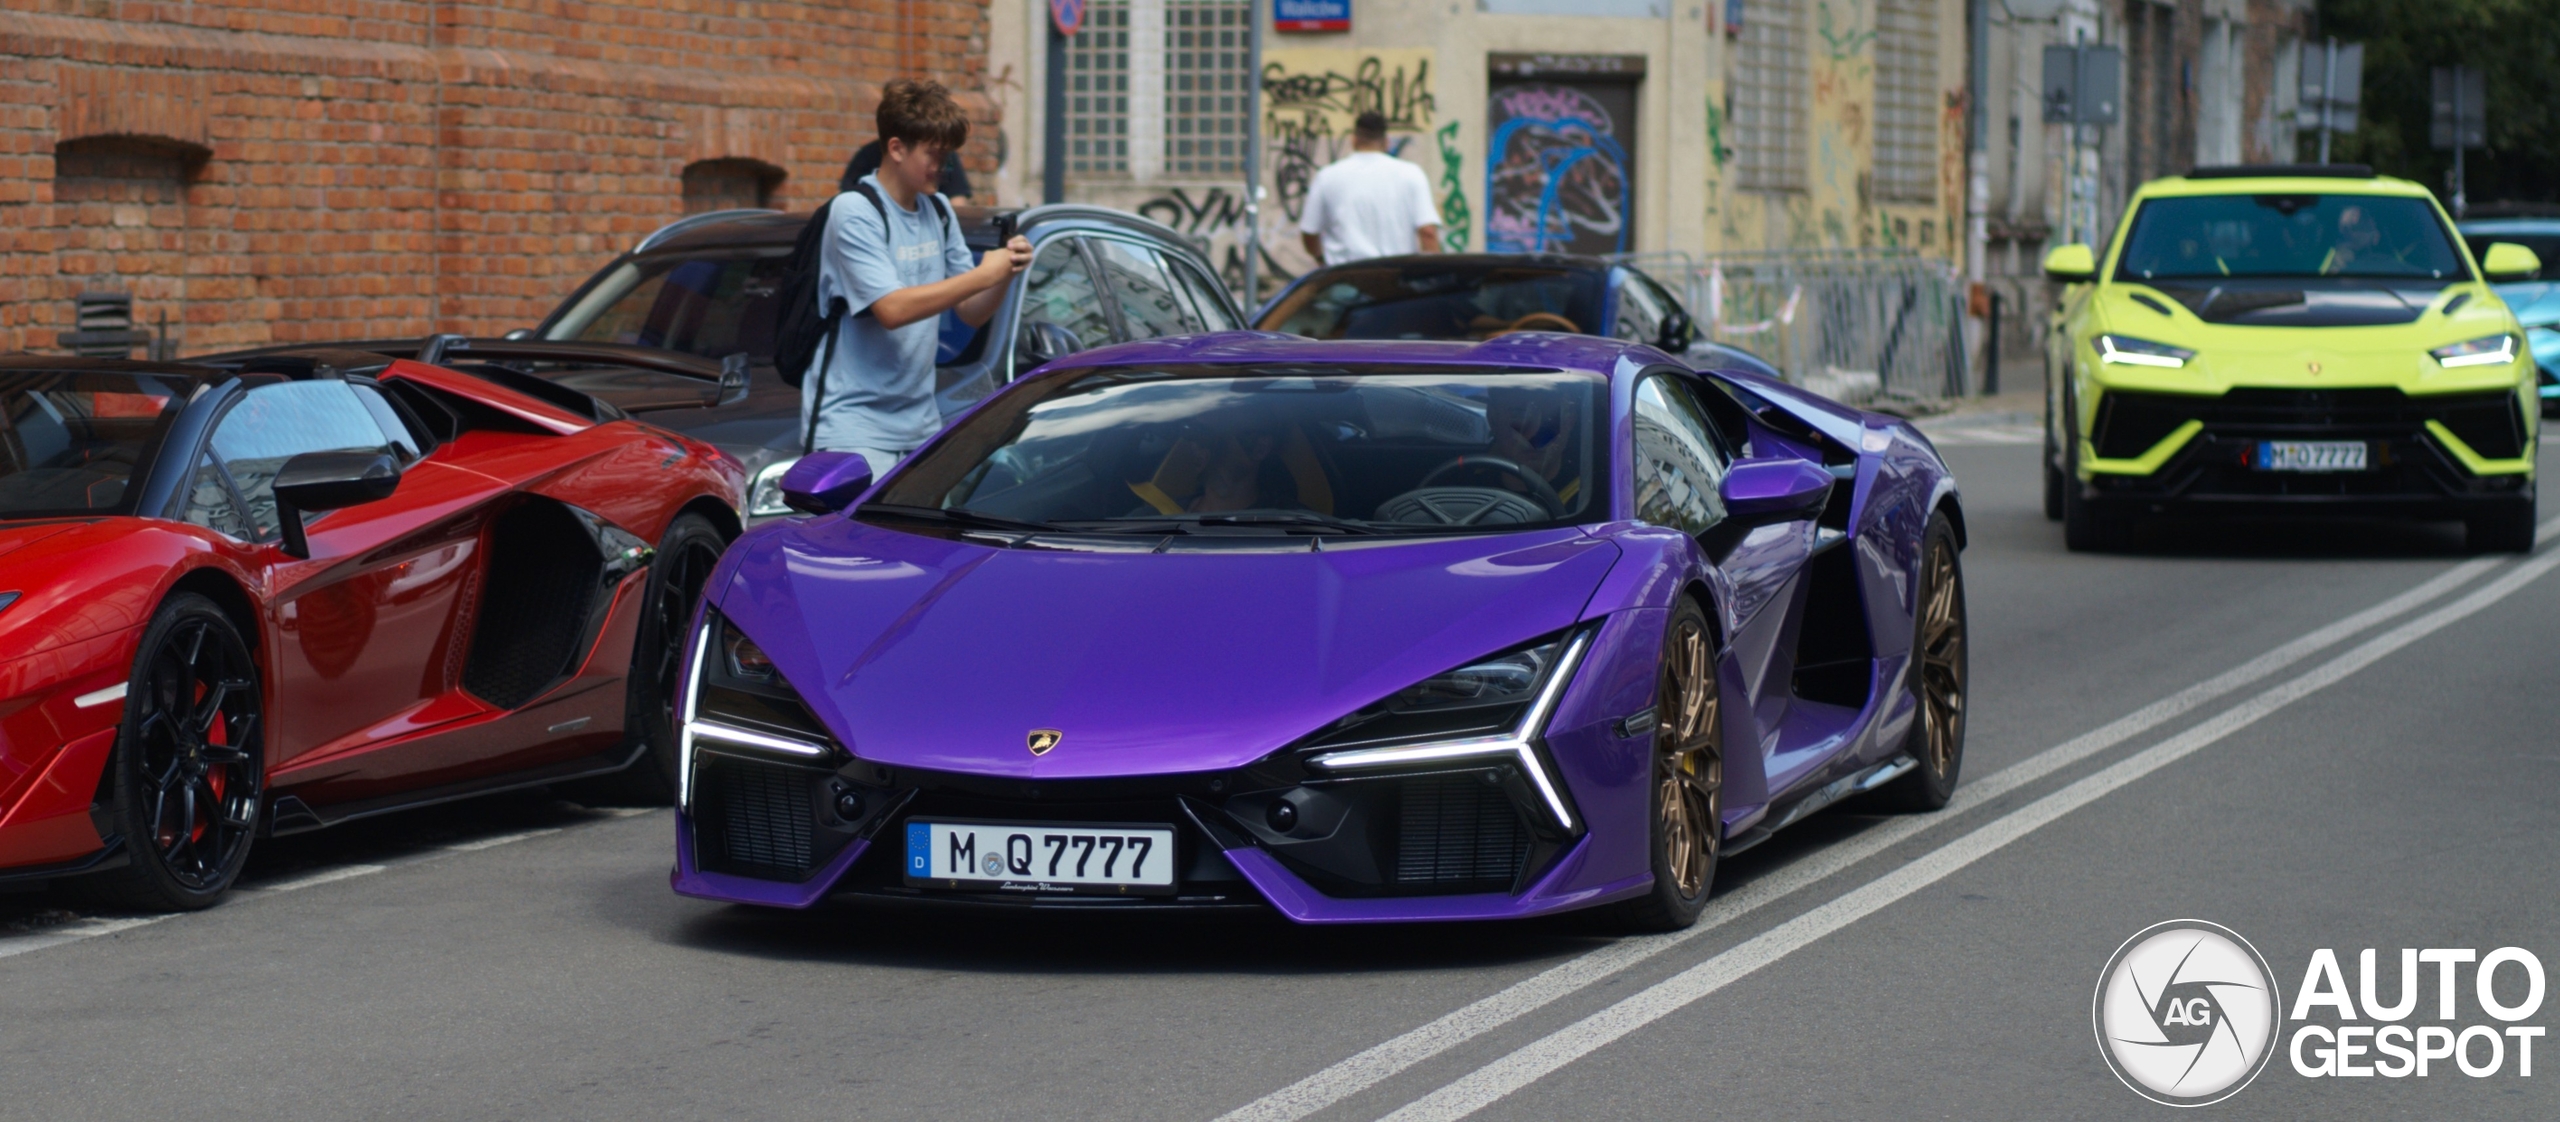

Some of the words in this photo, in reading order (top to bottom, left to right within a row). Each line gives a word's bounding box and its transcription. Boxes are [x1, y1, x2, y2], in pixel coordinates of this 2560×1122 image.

[914, 856, 925, 869] D
[949, 831, 975, 874] M
[1007, 833, 1032, 876] Q
[1044, 834, 1152, 878] 7777
